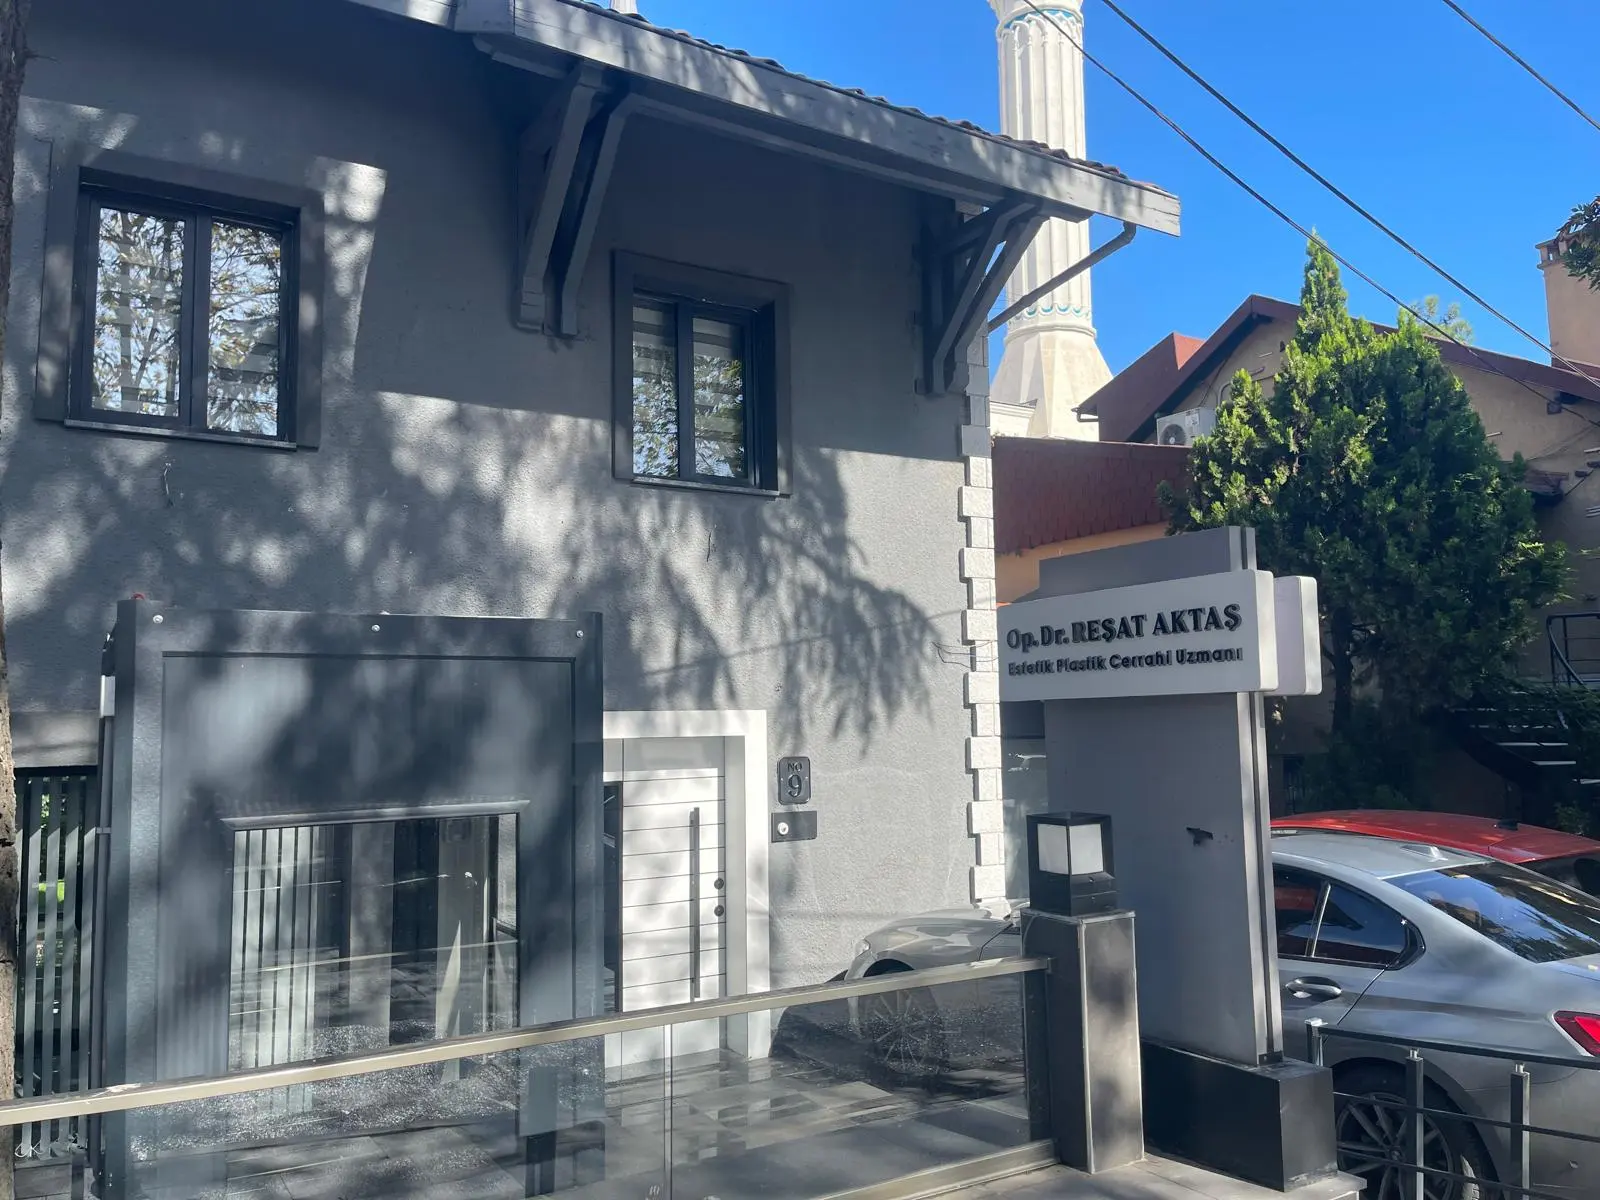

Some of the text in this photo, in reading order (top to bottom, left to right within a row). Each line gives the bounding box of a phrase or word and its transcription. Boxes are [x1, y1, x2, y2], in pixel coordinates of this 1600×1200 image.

[1071, 614, 1147, 643] REŞAT
[1152, 603, 1242, 636] AKTAŞ
[1008, 647, 1244, 676] Estetik Plastik Cerrahi Uzmanı
[788, 774, 802, 797] 9
